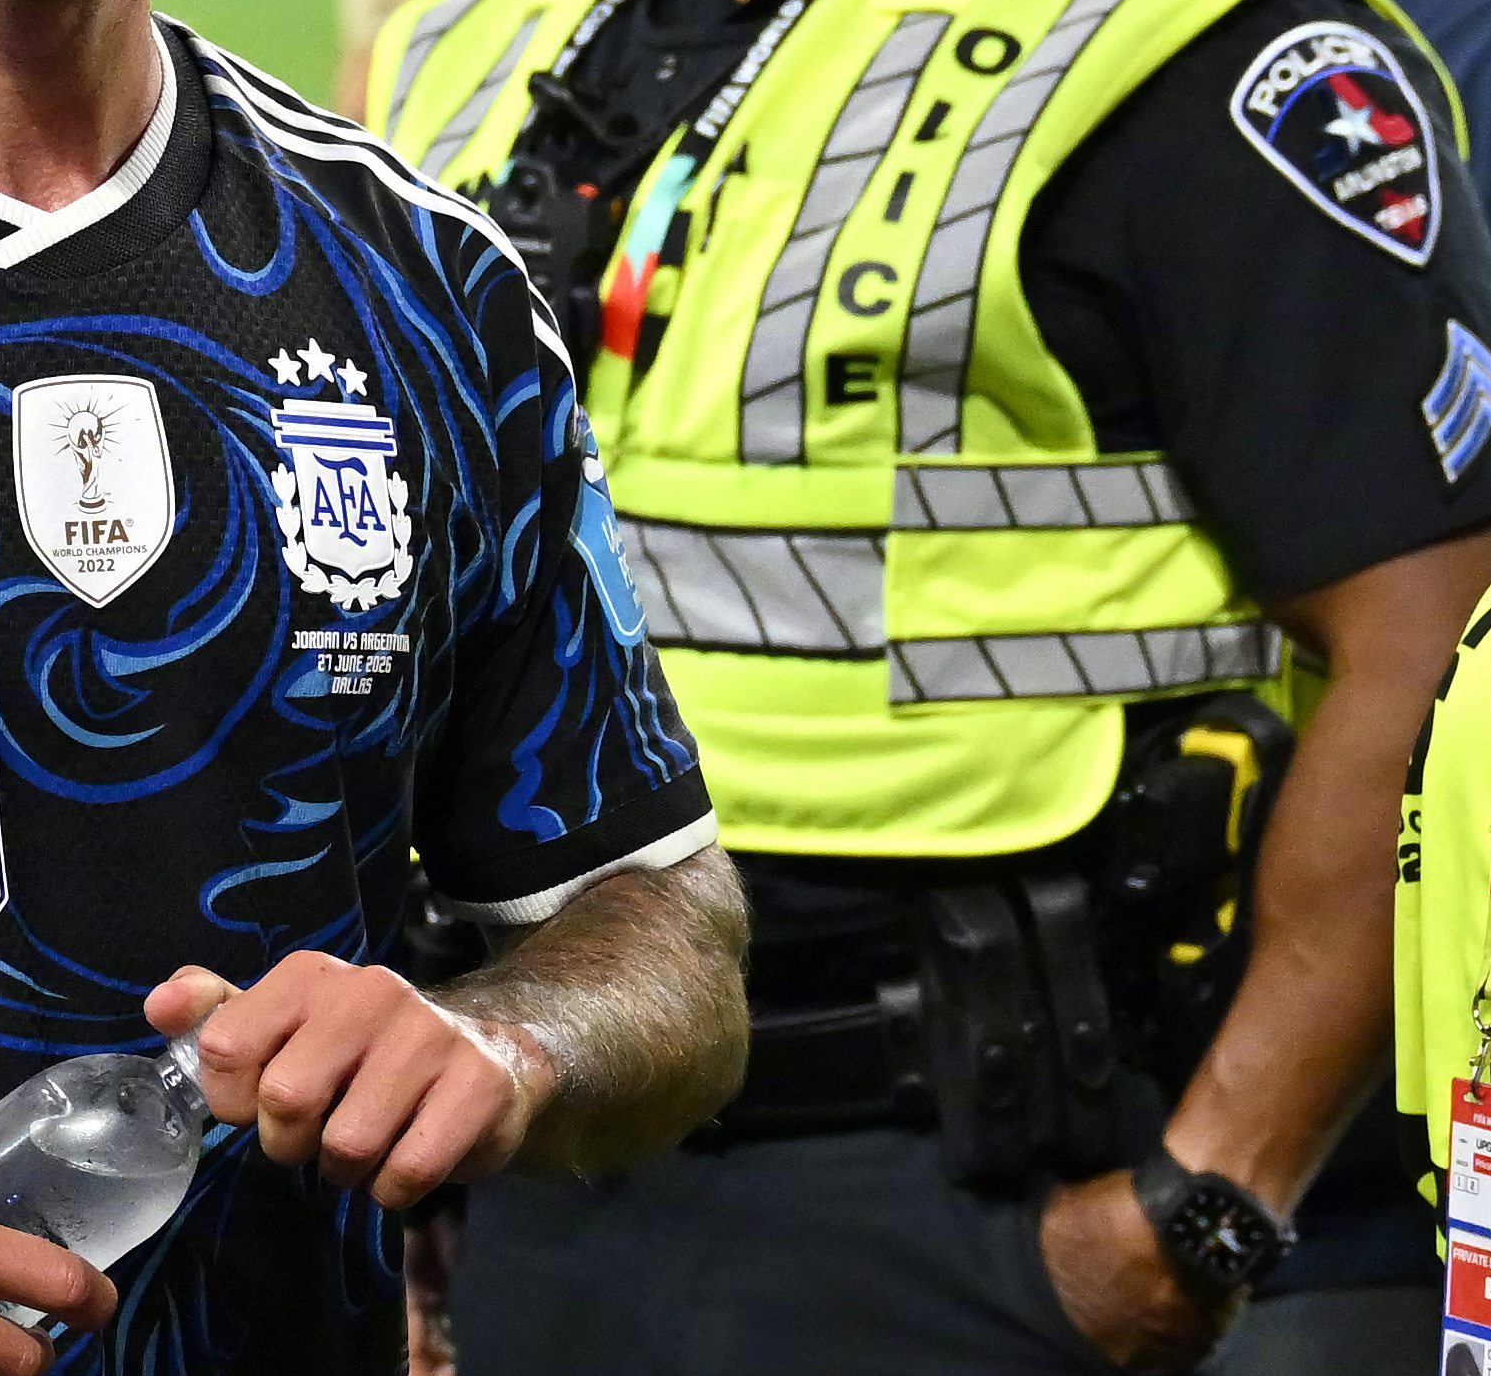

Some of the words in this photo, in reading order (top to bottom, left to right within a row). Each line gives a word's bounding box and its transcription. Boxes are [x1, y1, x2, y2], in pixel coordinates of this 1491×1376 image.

[1248, 36, 1378, 117] POLICE
[311, 452, 386, 547] AFA
[65, 519, 129, 546] FIFA
[52, 548, 83, 558] WORLD
[85, 545, 148, 557] CHAMPIONS
[77, 558, 116, 573] 2022
[291, 630, 340, 650] JORDAN
[343, 632, 358, 650] VS
[317, 654, 332, 672] 27
[334, 654, 363, 673] JUNE
[365, 655, 393, 673] 2026
[331, 677, 373, 695] DALLAS
[1452, 1247, 1489, 1268] PRIVATE
